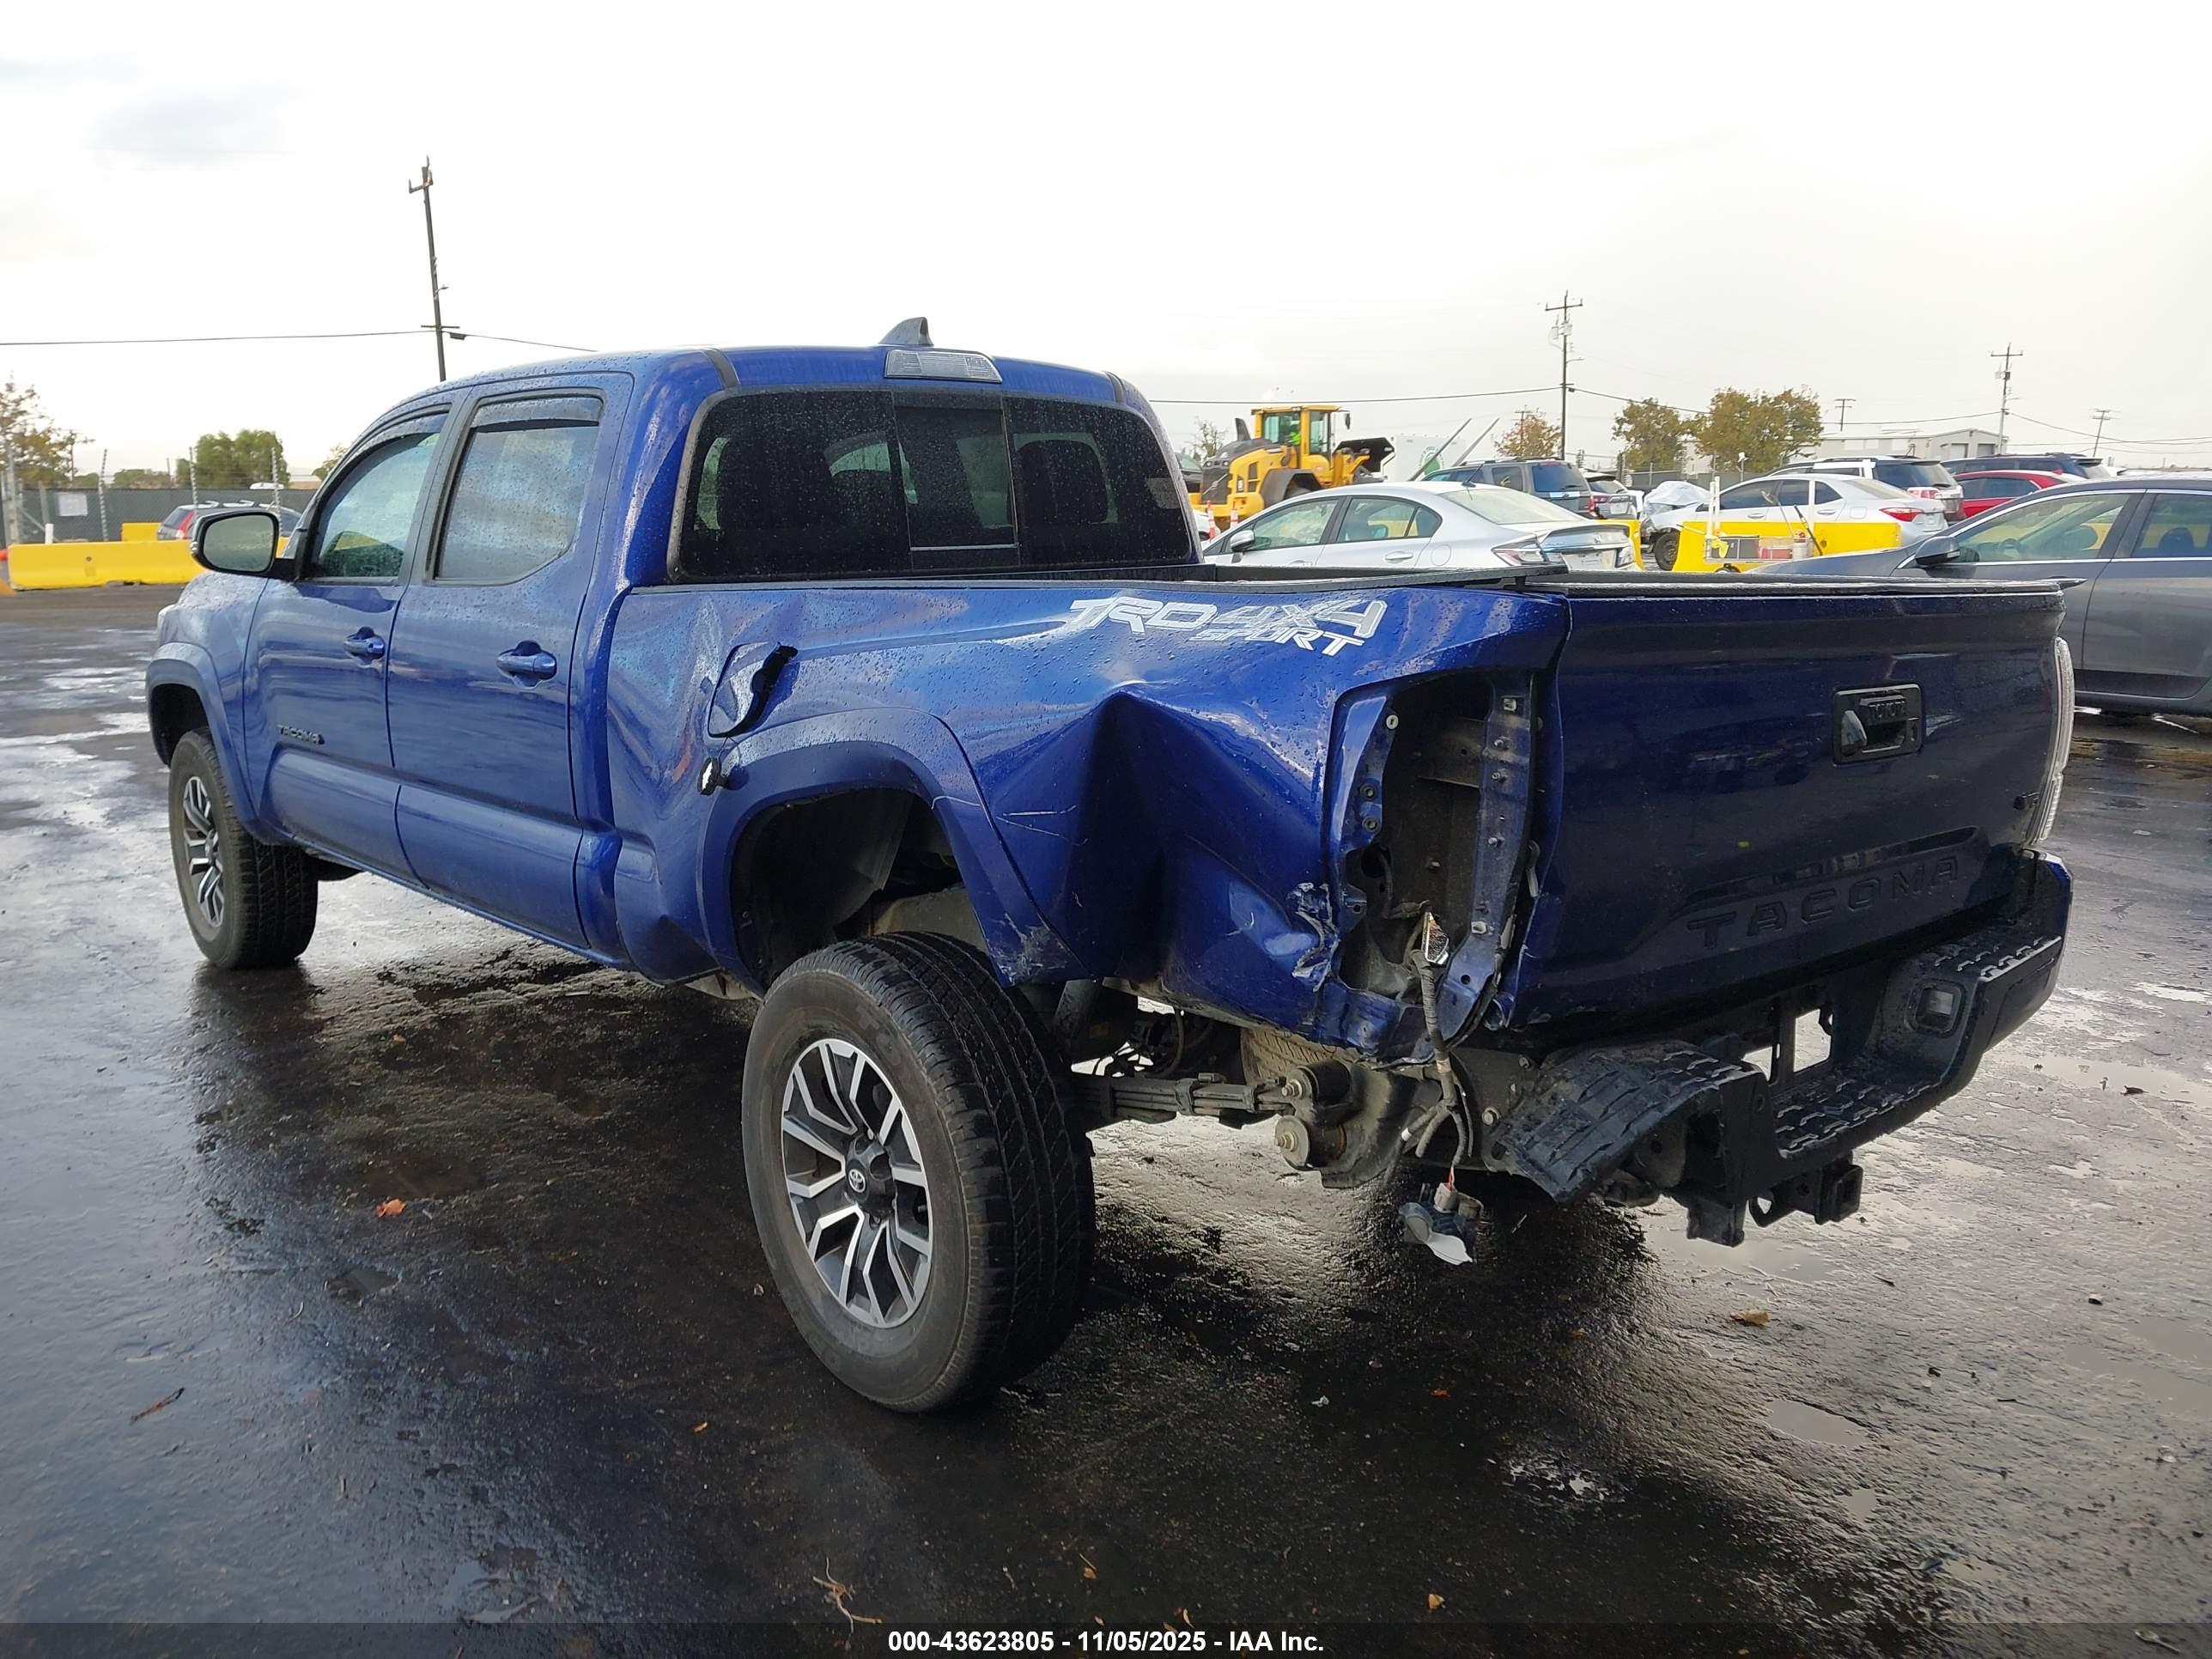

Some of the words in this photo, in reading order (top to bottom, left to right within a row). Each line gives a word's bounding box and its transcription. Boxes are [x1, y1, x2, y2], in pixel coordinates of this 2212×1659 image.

[1070, 596, 1218, 635] TRD
[1188, 627, 1365, 657] SPORT
[1686, 855, 1960, 949] TACOMA
